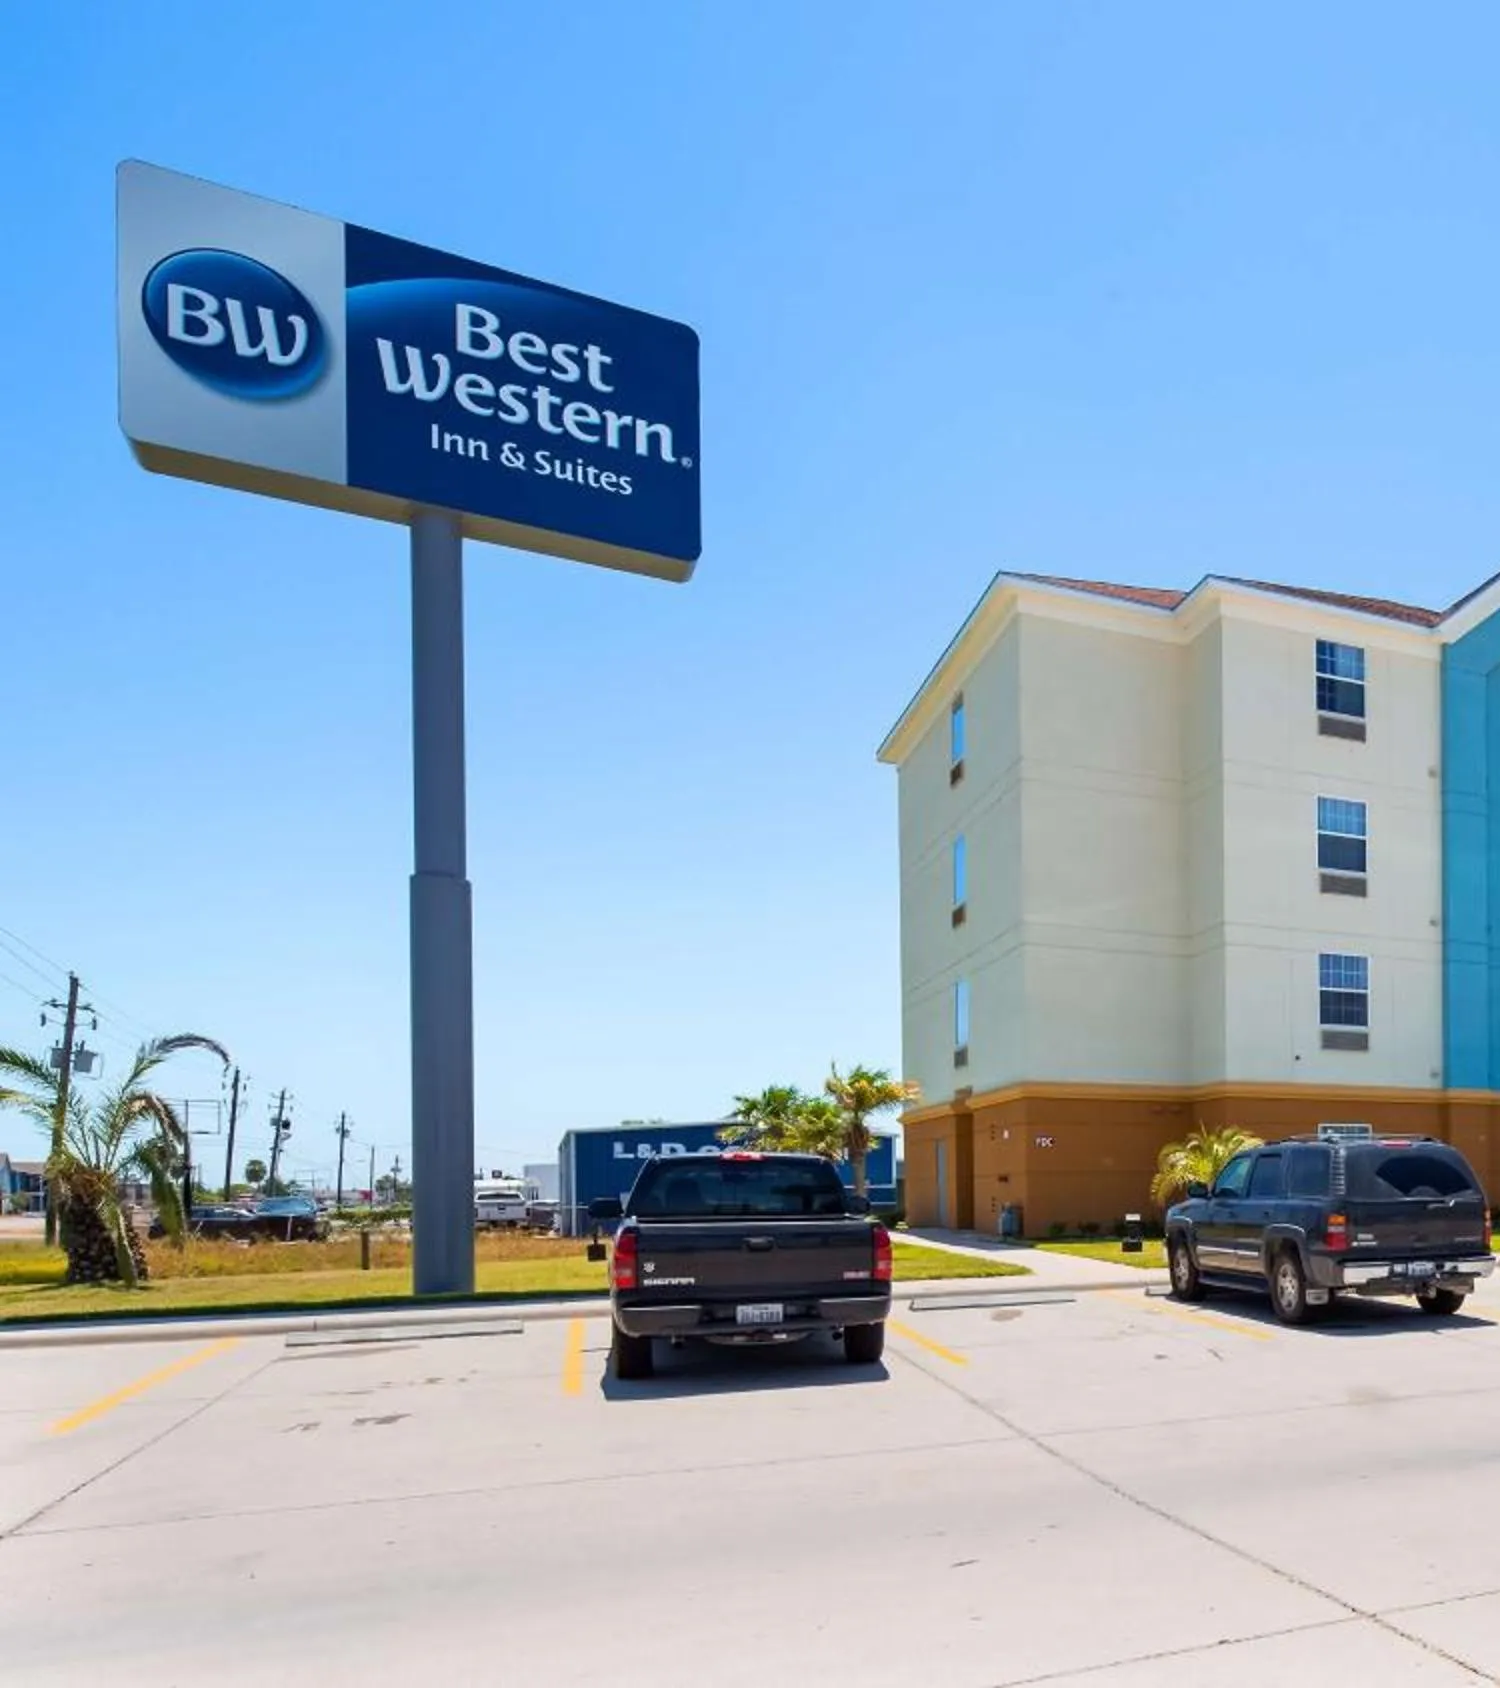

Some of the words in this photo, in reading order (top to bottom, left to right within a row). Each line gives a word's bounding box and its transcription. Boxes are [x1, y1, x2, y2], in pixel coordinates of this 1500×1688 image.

[166, 282, 308, 367] BW
[454, 302, 614, 394] Best
[375, 337, 678, 464] Western
[430, 423, 490, 462] Inn
[500, 442, 526, 470] &
[534, 451, 634, 496] Suites
